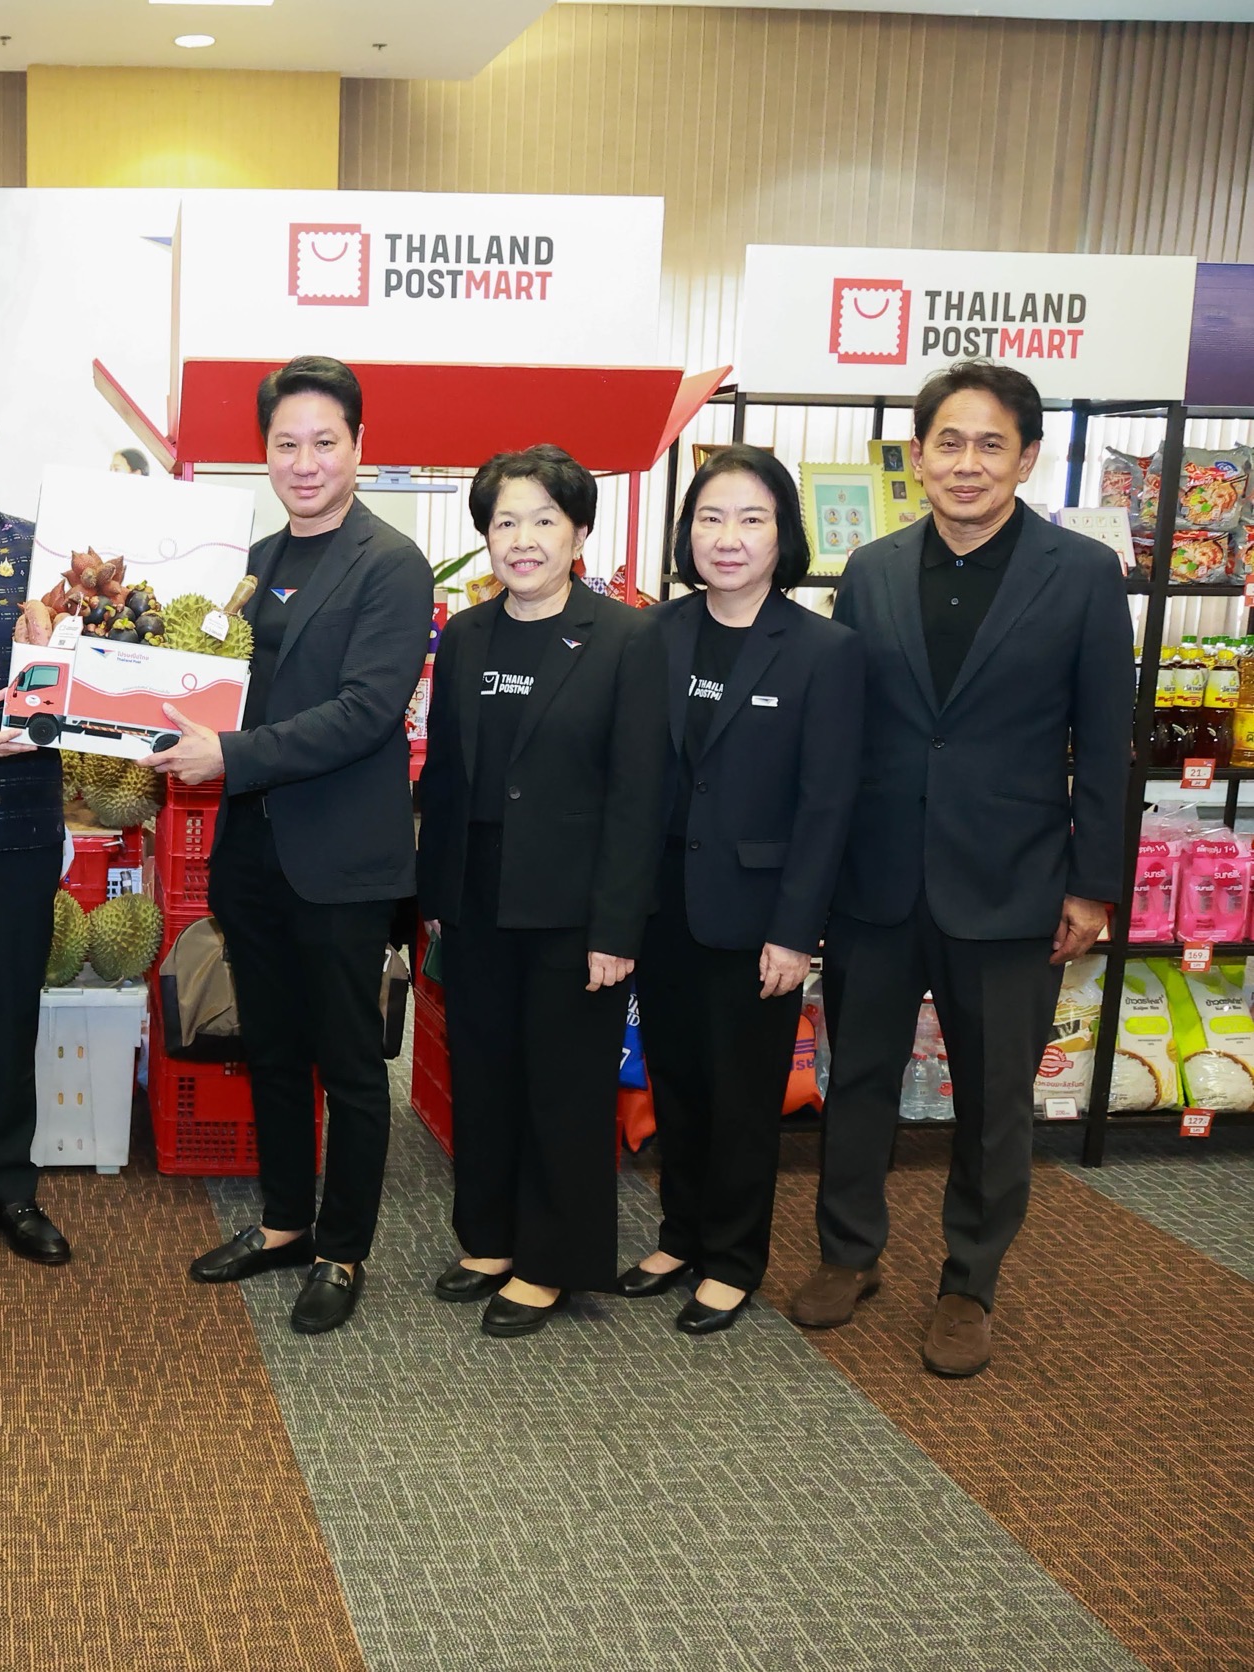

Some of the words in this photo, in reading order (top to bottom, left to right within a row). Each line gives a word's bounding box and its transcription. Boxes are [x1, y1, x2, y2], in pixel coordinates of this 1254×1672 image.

[385, 233, 554, 265] THAILAND
[385, 269, 553, 300] POSTMART
[924, 290, 1087, 324] THAILAND
[922, 326, 1084, 359] POSTMART
[498, 683, 532, 695] POSTMA
